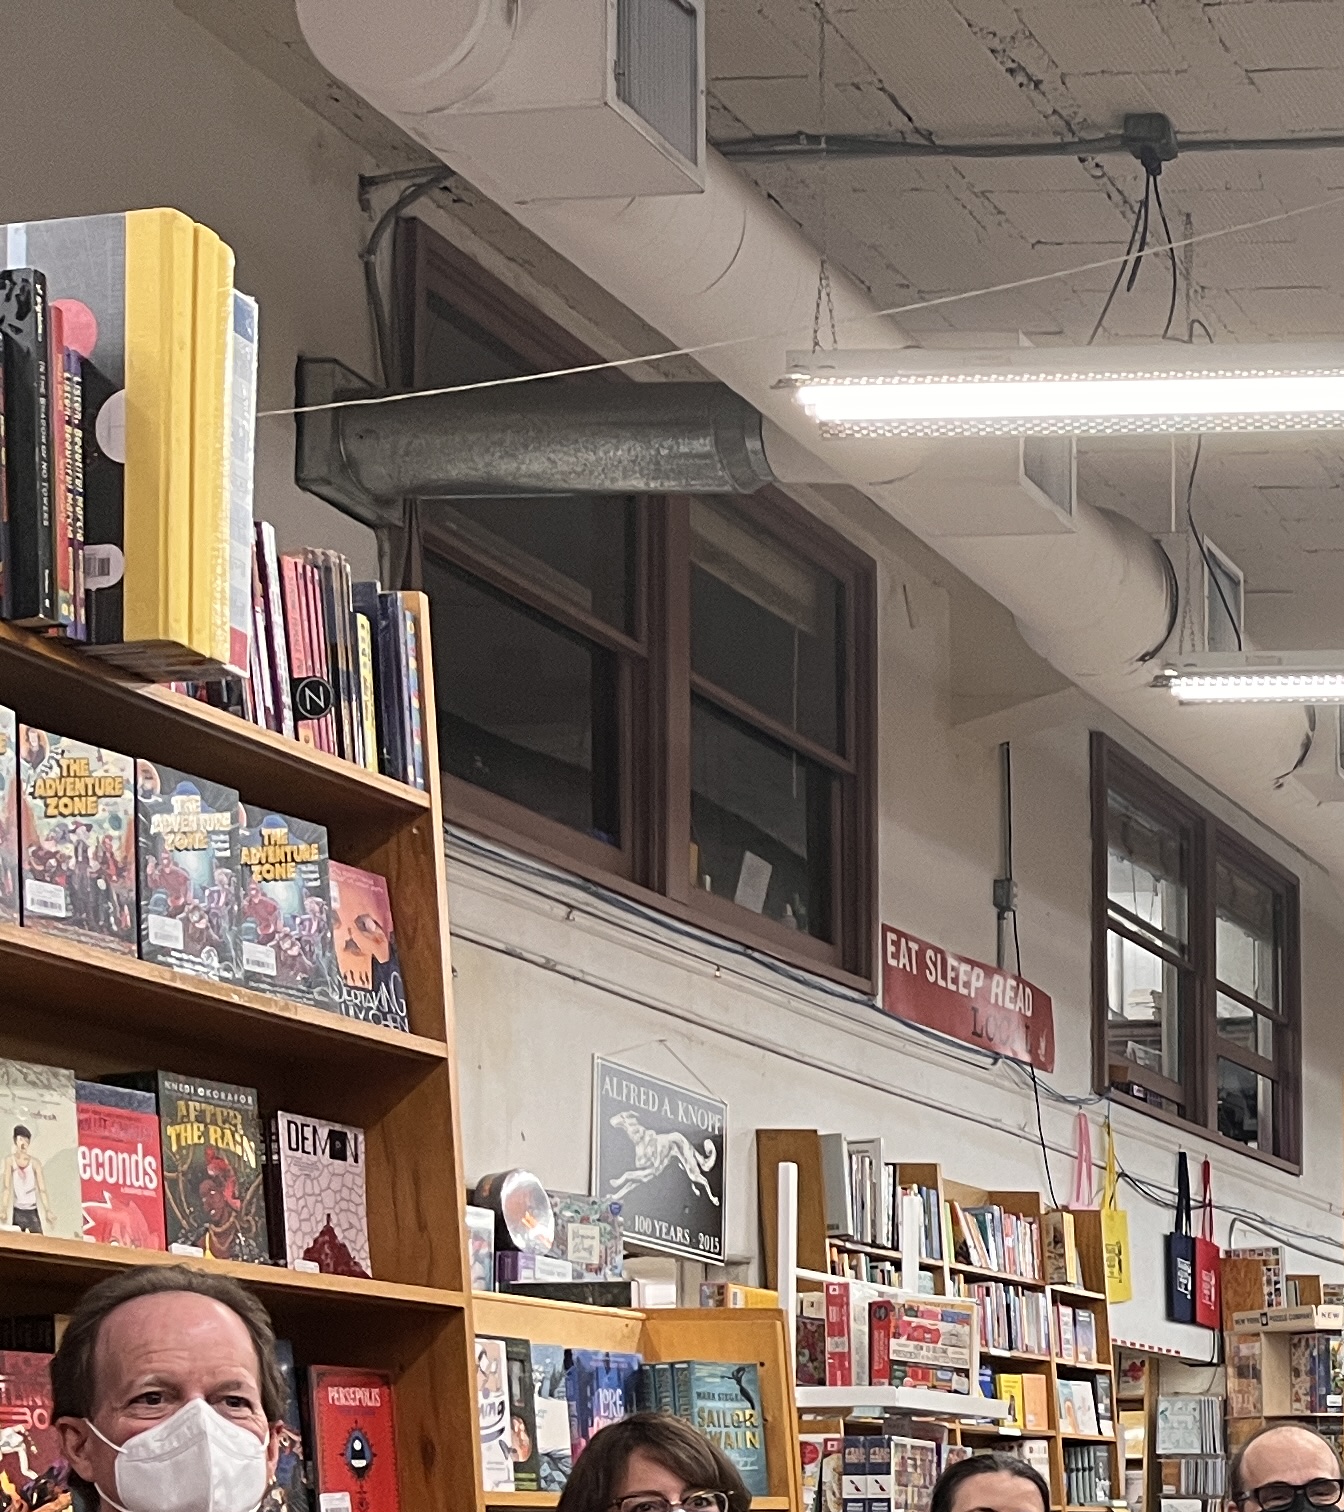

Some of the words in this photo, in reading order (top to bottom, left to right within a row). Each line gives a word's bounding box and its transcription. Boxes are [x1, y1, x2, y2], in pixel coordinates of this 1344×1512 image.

[304, 685, 326, 711] N
[59, 757, 90, 778] THE
[34, 776, 125, 799] ADVENTURE
[45, 796, 98, 818] ZONE
[151, 811, 232, 834] ADVENTURE
[164, 831, 209, 852] ZONE
[261, 827, 290, 846] THE
[240, 843, 319, 866] ADVENTURE
[251, 862, 297, 883] ZONE
[886, 930, 919, 976] EAT
[925, 948, 986, 999] SLEEP
[990, 973, 1034, 1018] READ
[971, 1005, 1031, 1052] LOCAL
[602, 1074, 659, 1113] ALFRED
[661, 1099, 674, 1120] A.
[678, 1100, 723, 1136] KNOPF
[176, 1100, 245, 1135] AFTER
[166, 1121, 206, 1153] THE
[208, 1124, 258, 1169] RAIN
[77, 1142, 159, 1190] econds
[634, 1213, 652, 1234] 100
[654, 1221, 691, 1245] YEARS
[698, 1232, 721, 1255] 2015
[1320, 1311, 1340, 1319] NEW
[327, 1386, 382, 1408] PERSEPOLIS
[696, 1407, 760, 1430] SAILOR
[706, 1429, 761, 1451] WAIN
